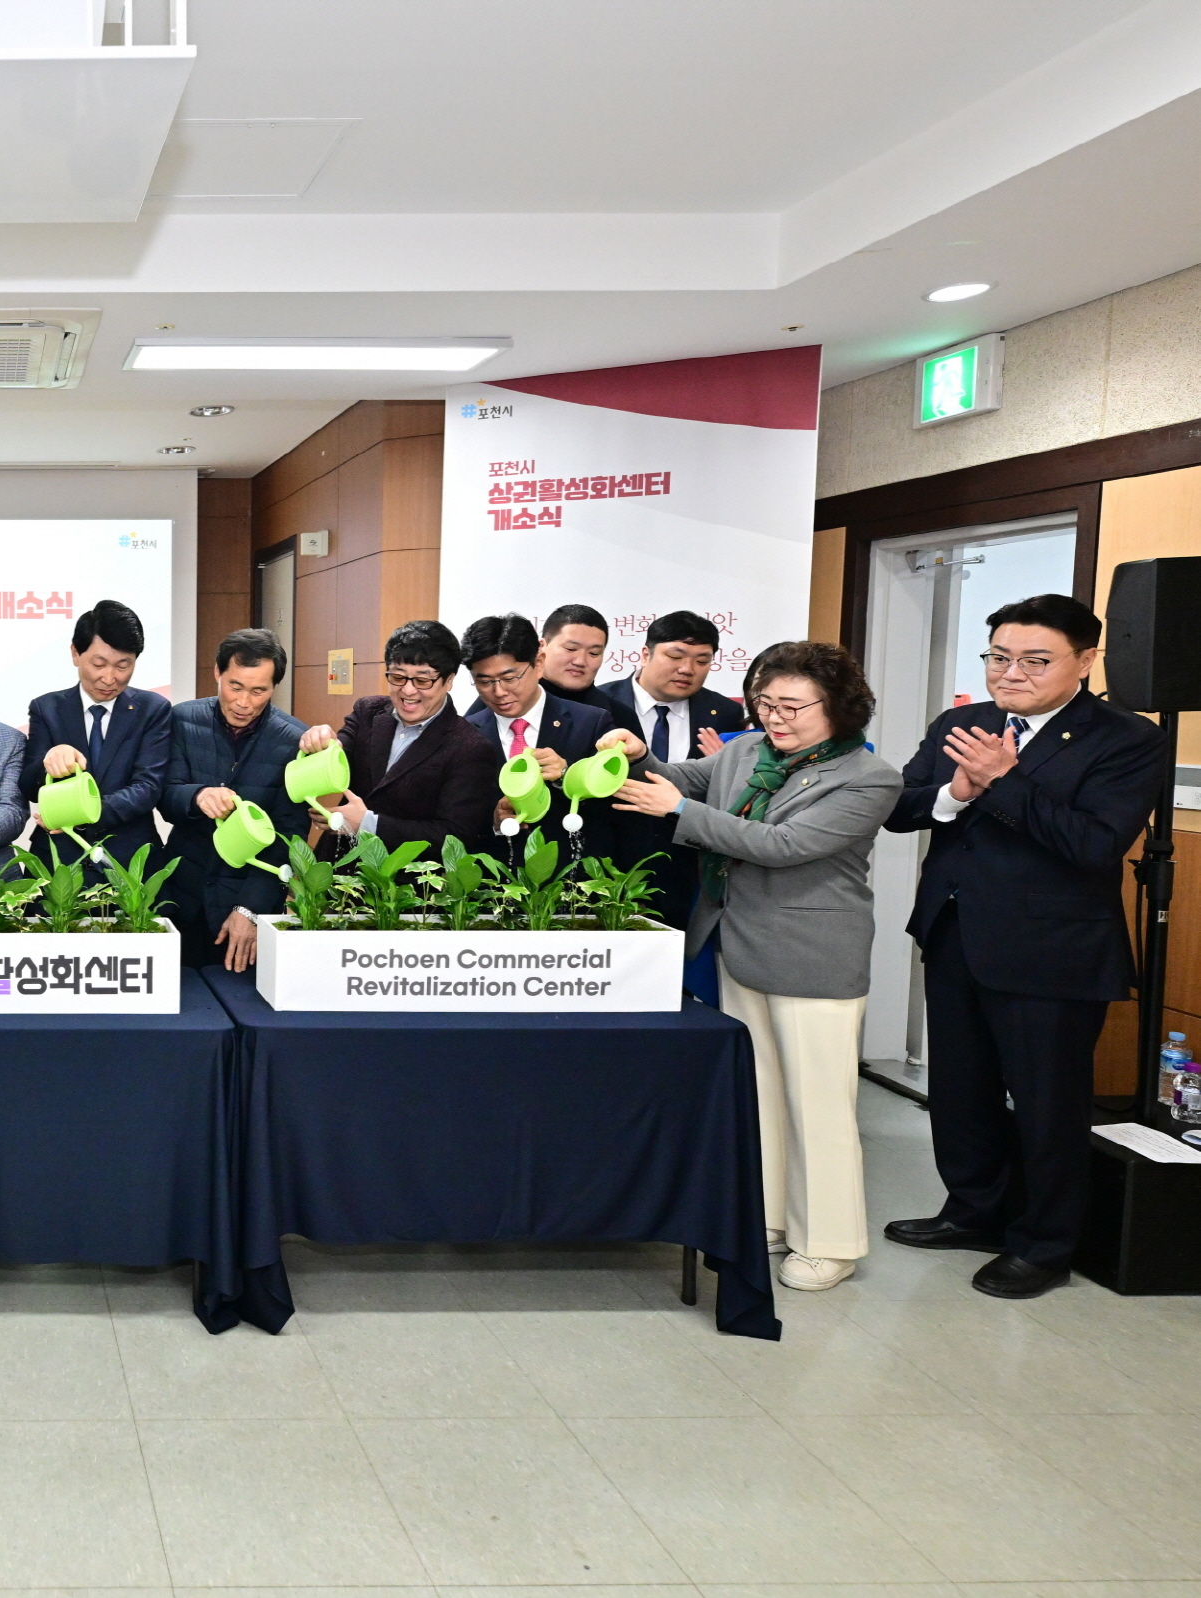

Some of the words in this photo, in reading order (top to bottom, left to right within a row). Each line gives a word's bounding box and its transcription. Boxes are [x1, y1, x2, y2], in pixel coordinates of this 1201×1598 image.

[478, 405, 513, 420] 포천시
[488, 459, 536, 478] 포천시
[488, 471, 671, 505] 상권활성화센터
[487, 505, 562, 531] 개소식
[131, 539, 157, 550] 포천시
[341, 948, 450, 969] Pochoen
[457, 947, 611, 970] Commercial
[346, 975, 516, 997] Revitalization
[523, 975, 611, 997] Center
